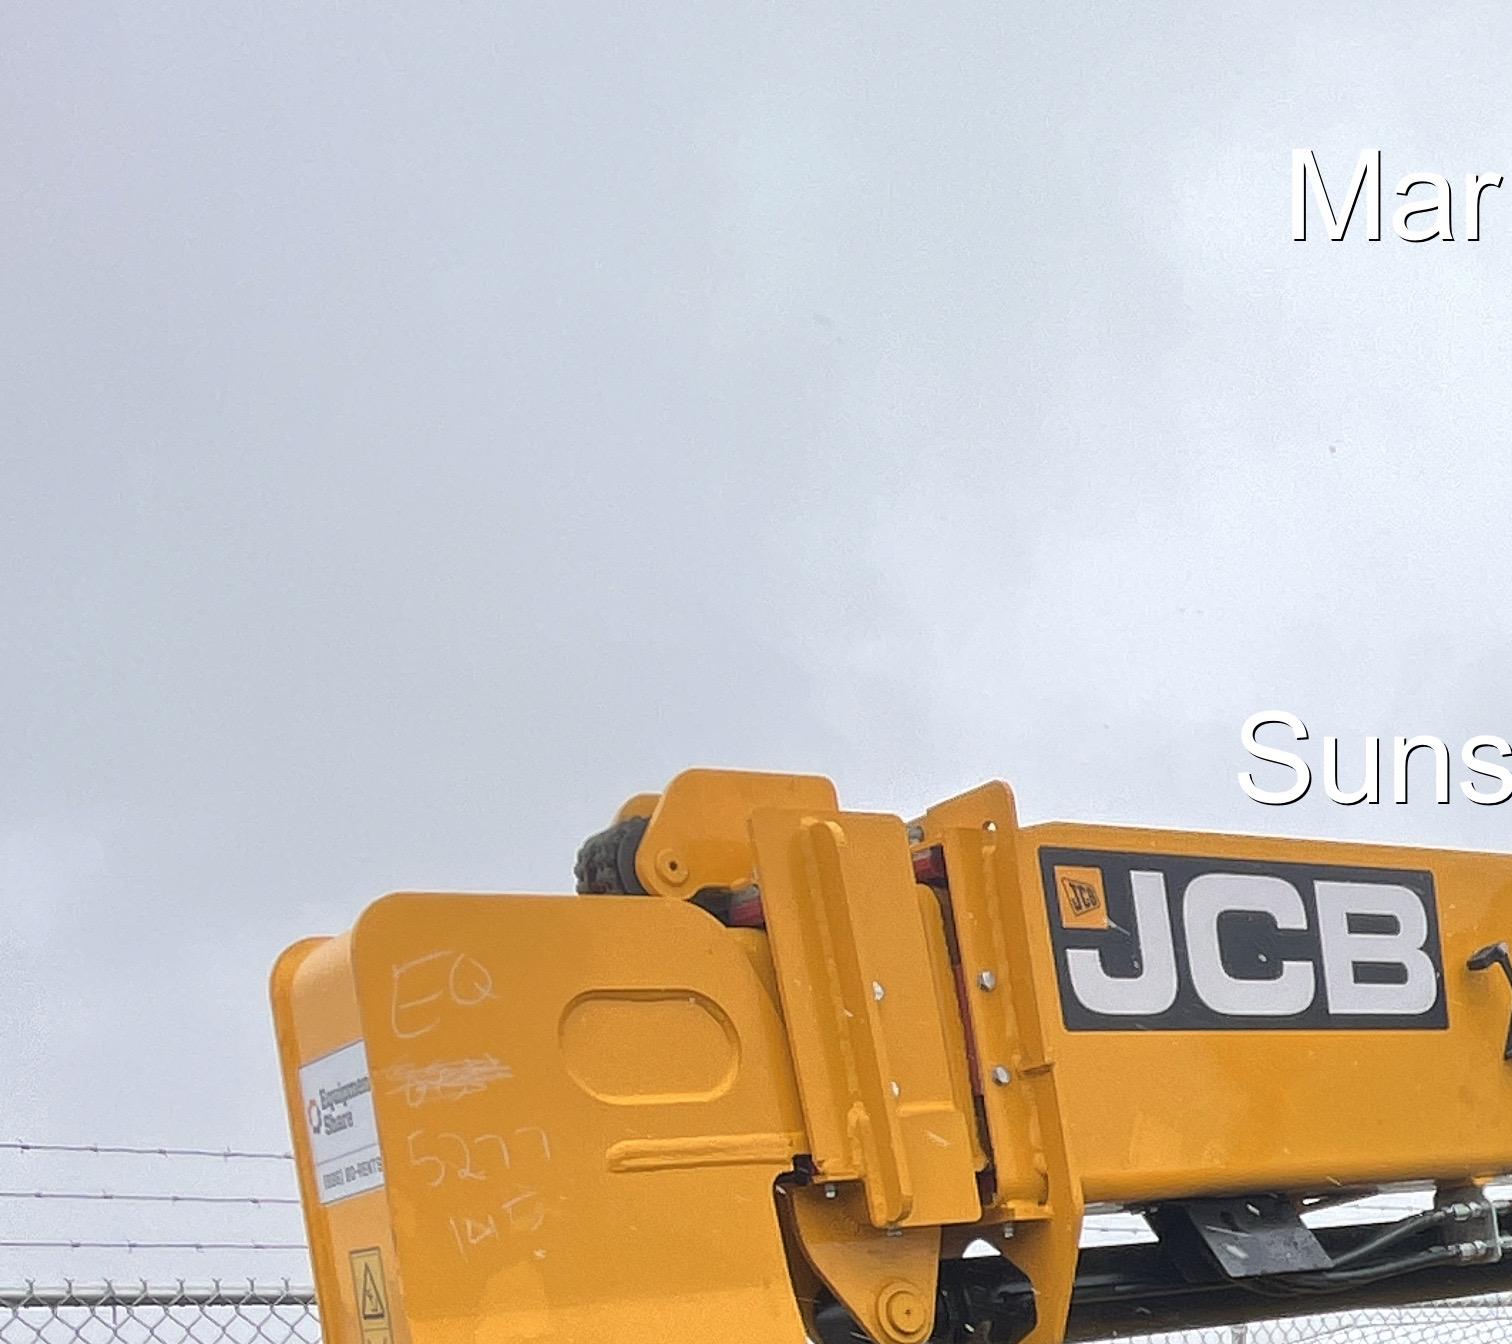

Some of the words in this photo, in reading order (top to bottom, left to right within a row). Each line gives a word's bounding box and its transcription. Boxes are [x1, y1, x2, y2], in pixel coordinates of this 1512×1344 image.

[1065, 870, 1438, 1016] JCB
[391, 949, 500, 1040] EQ
[319, 1076, 371, 1111] Equipmen
